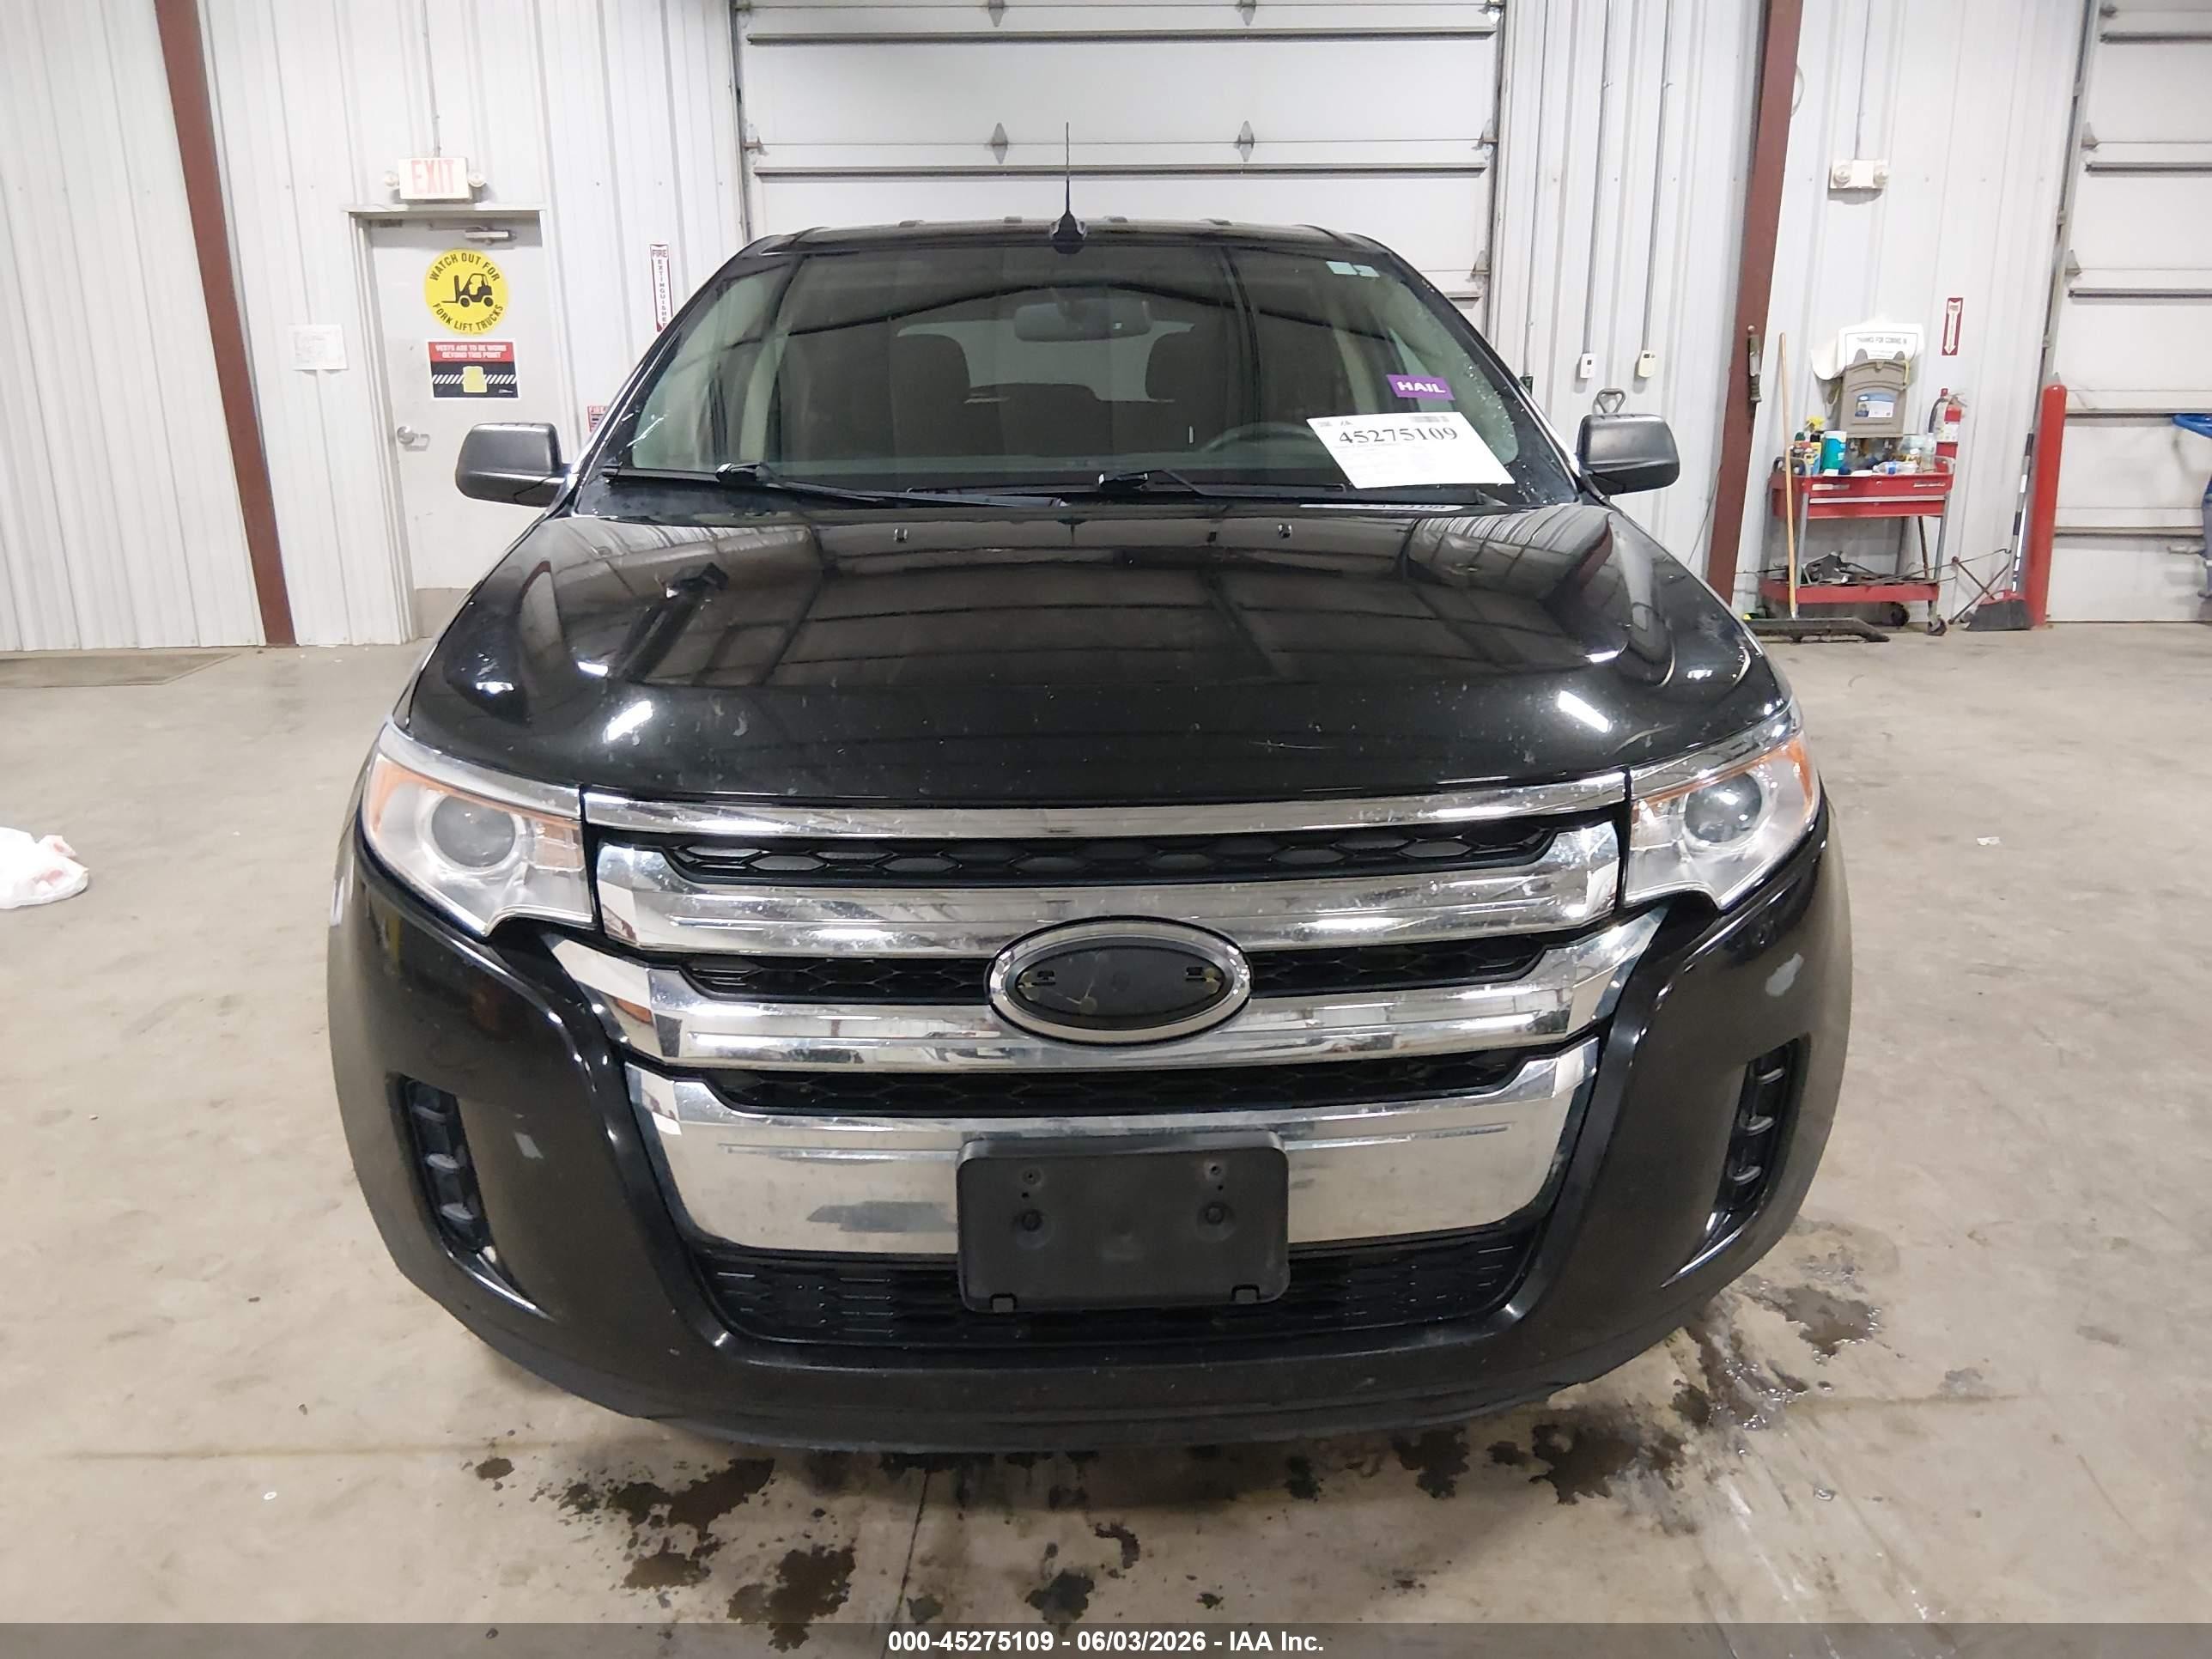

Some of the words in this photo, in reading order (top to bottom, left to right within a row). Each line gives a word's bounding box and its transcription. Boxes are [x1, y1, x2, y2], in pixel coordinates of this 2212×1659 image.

[411, 160, 454, 194] EXIT
[652, 249, 667, 258] FIRE
[429, 253, 459, 281] WATCH
[461, 252, 482, 265] OUT
[483, 261, 501, 282] FOR
[432, 302, 453, 325] FORK
[453, 320, 473, 331] LIFT
[475, 304, 504, 331] TRUCKS
[1396, 380, 1447, 393] HAIL
[1339, 427, 1458, 444] 45275109
